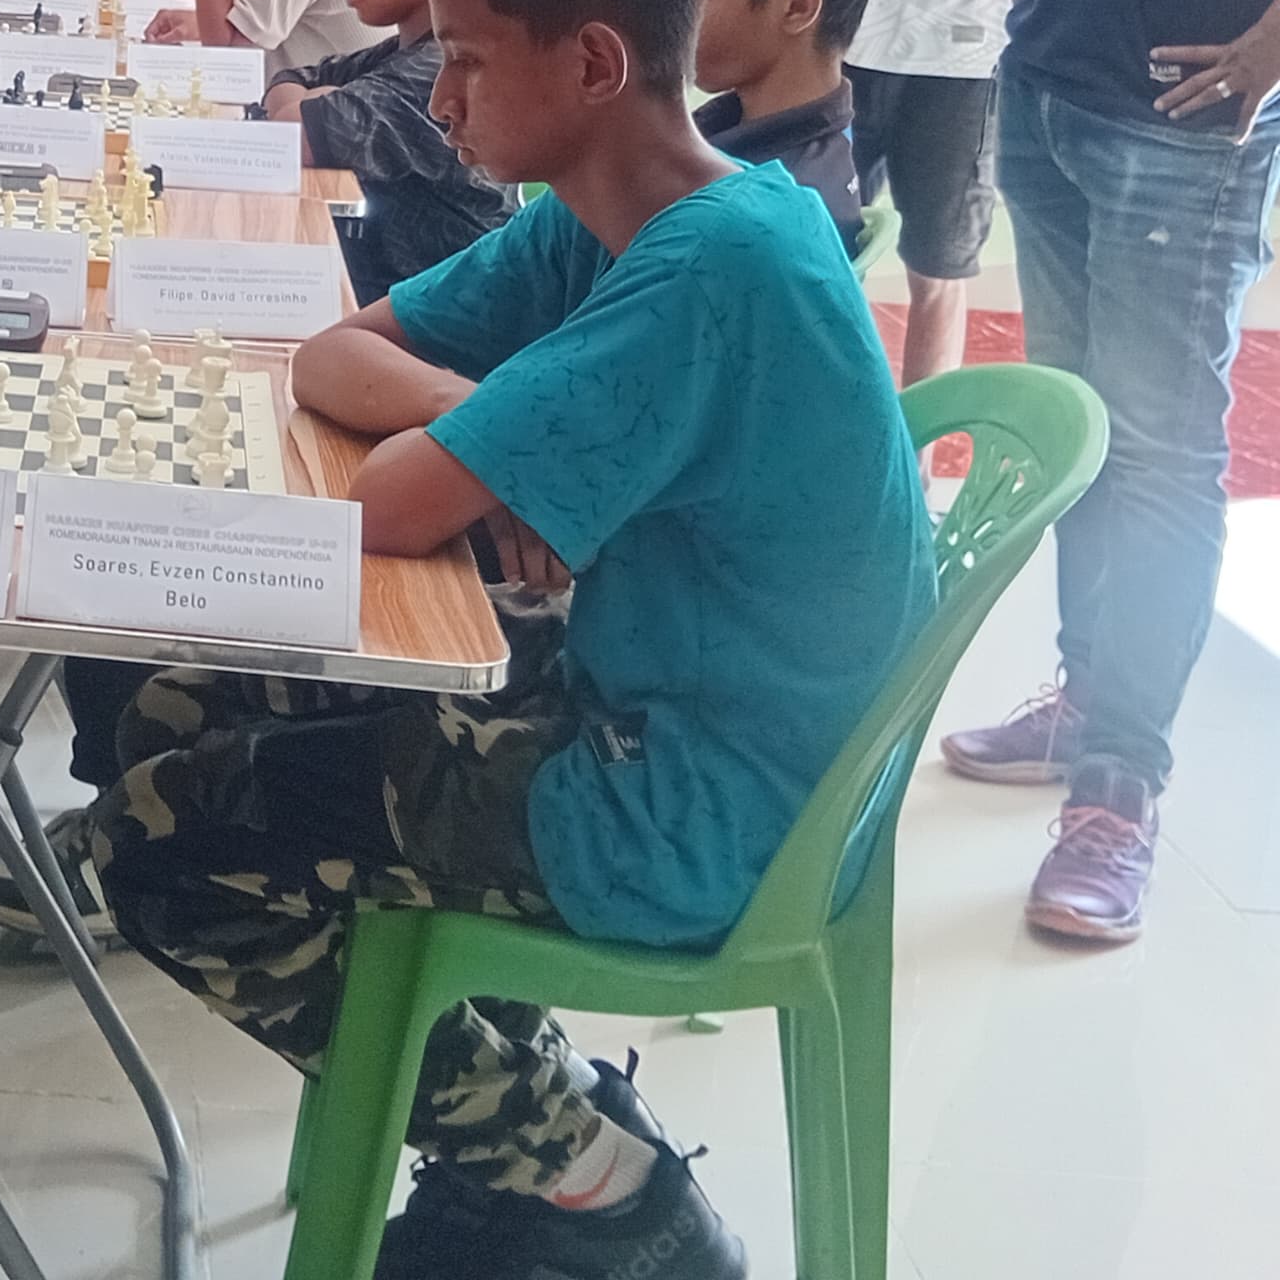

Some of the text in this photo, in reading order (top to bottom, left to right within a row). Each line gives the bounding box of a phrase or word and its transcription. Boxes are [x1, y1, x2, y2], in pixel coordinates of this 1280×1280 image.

[201, 289, 235, 302] David
[73, 552, 325, 590] Soares, Evzen Constantino
[165, 589, 207, 609] Belo
